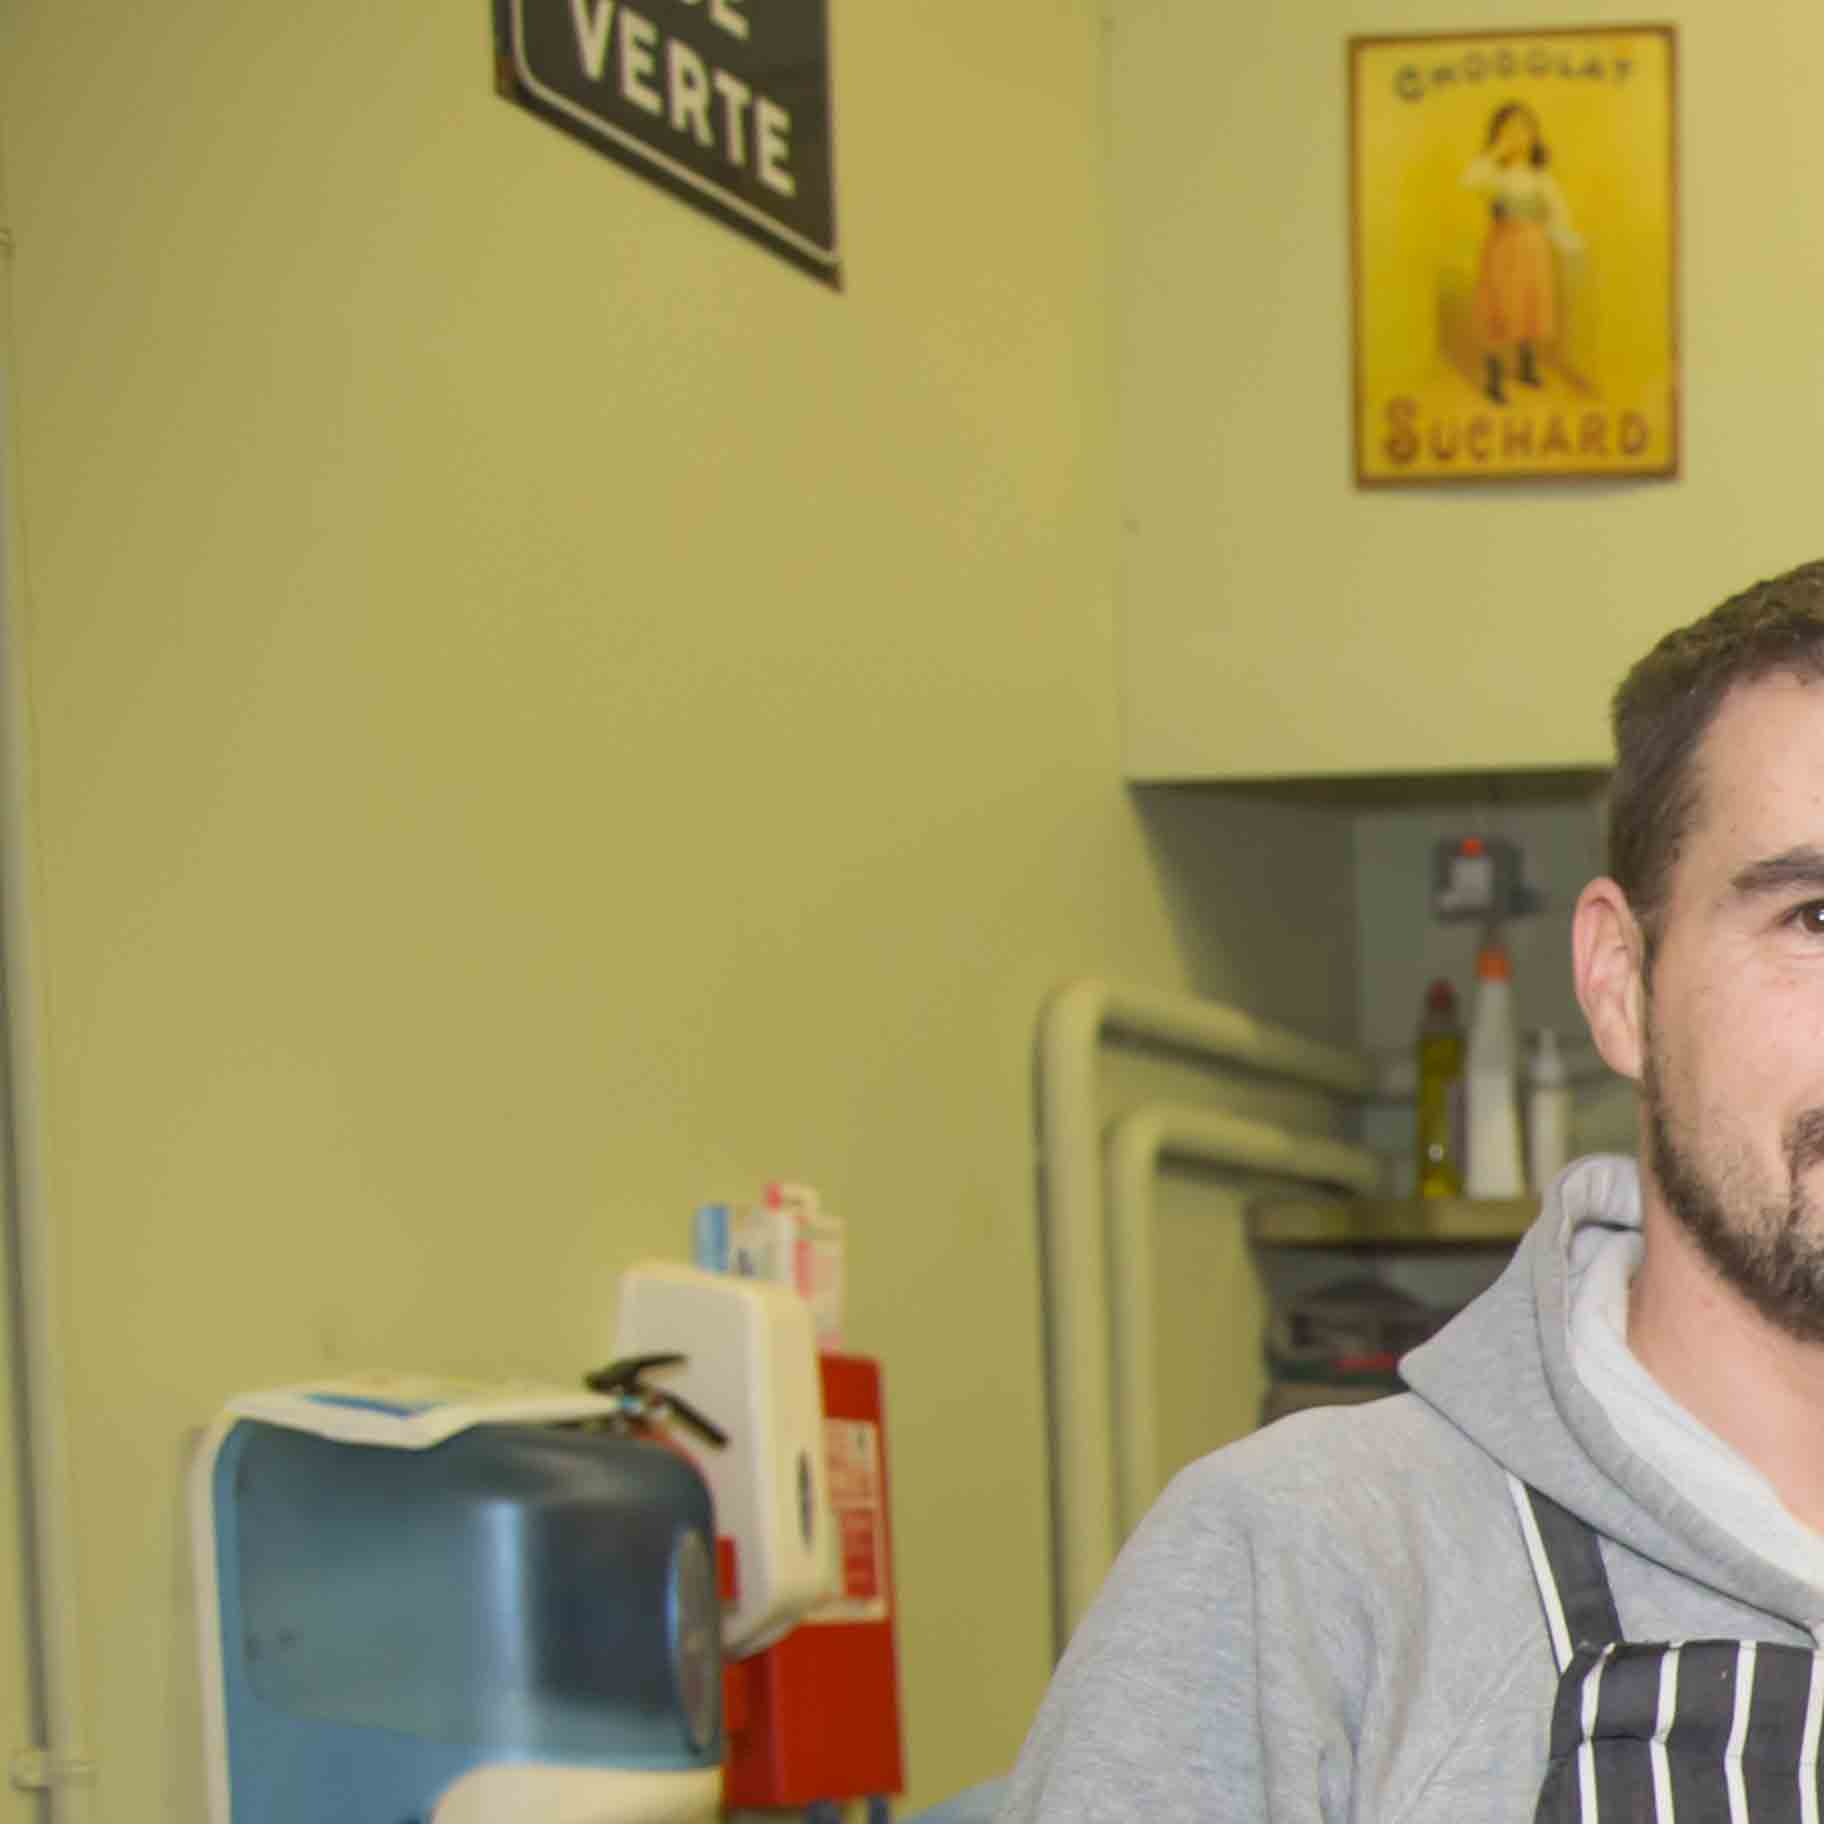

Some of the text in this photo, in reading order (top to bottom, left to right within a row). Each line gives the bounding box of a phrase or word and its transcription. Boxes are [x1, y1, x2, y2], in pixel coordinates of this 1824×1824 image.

[571, 0, 797, 198] VERTE
[1392, 47, 1635, 104] CHOCOLAT
[1384, 394, 1652, 467] SUCHARD
